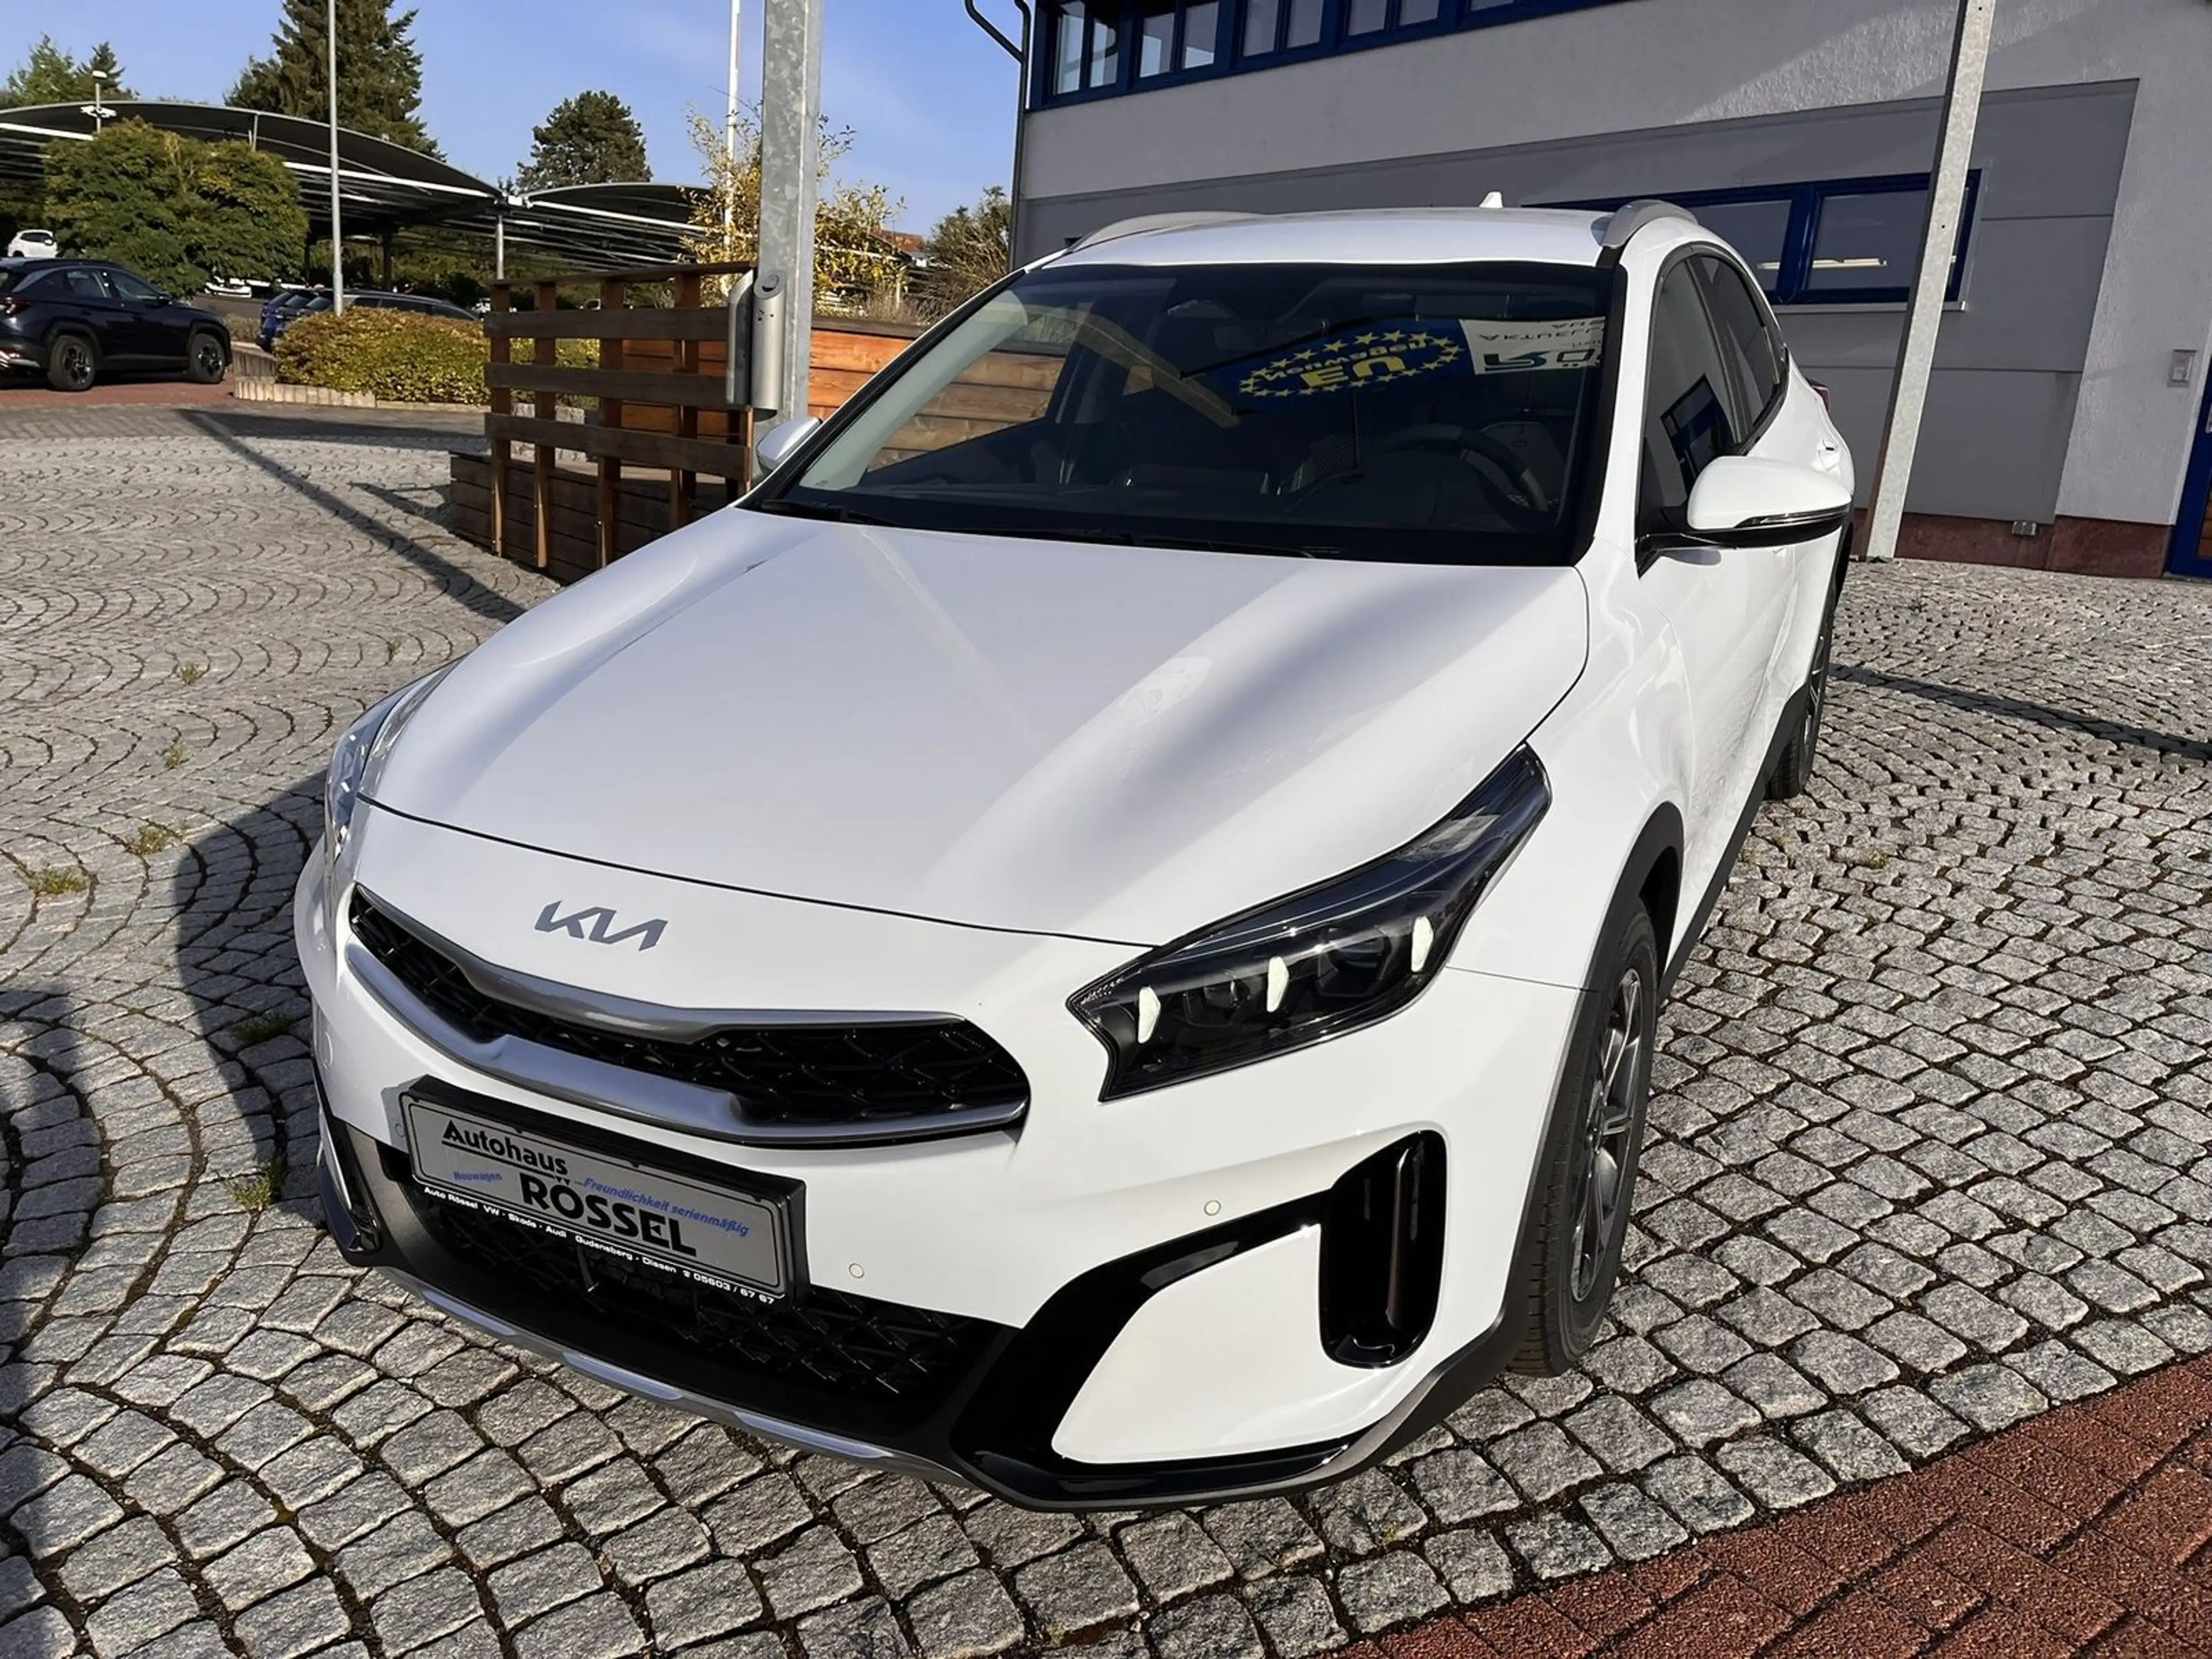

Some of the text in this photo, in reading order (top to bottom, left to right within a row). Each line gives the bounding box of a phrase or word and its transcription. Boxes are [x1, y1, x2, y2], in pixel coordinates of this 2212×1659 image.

[534, 900, 669, 952] KIA
[442, 1119, 569, 1176] Autohaus
[520, 1172, 696, 1257] RÖSSEL
[546, 1225, 567, 1238] Audi
